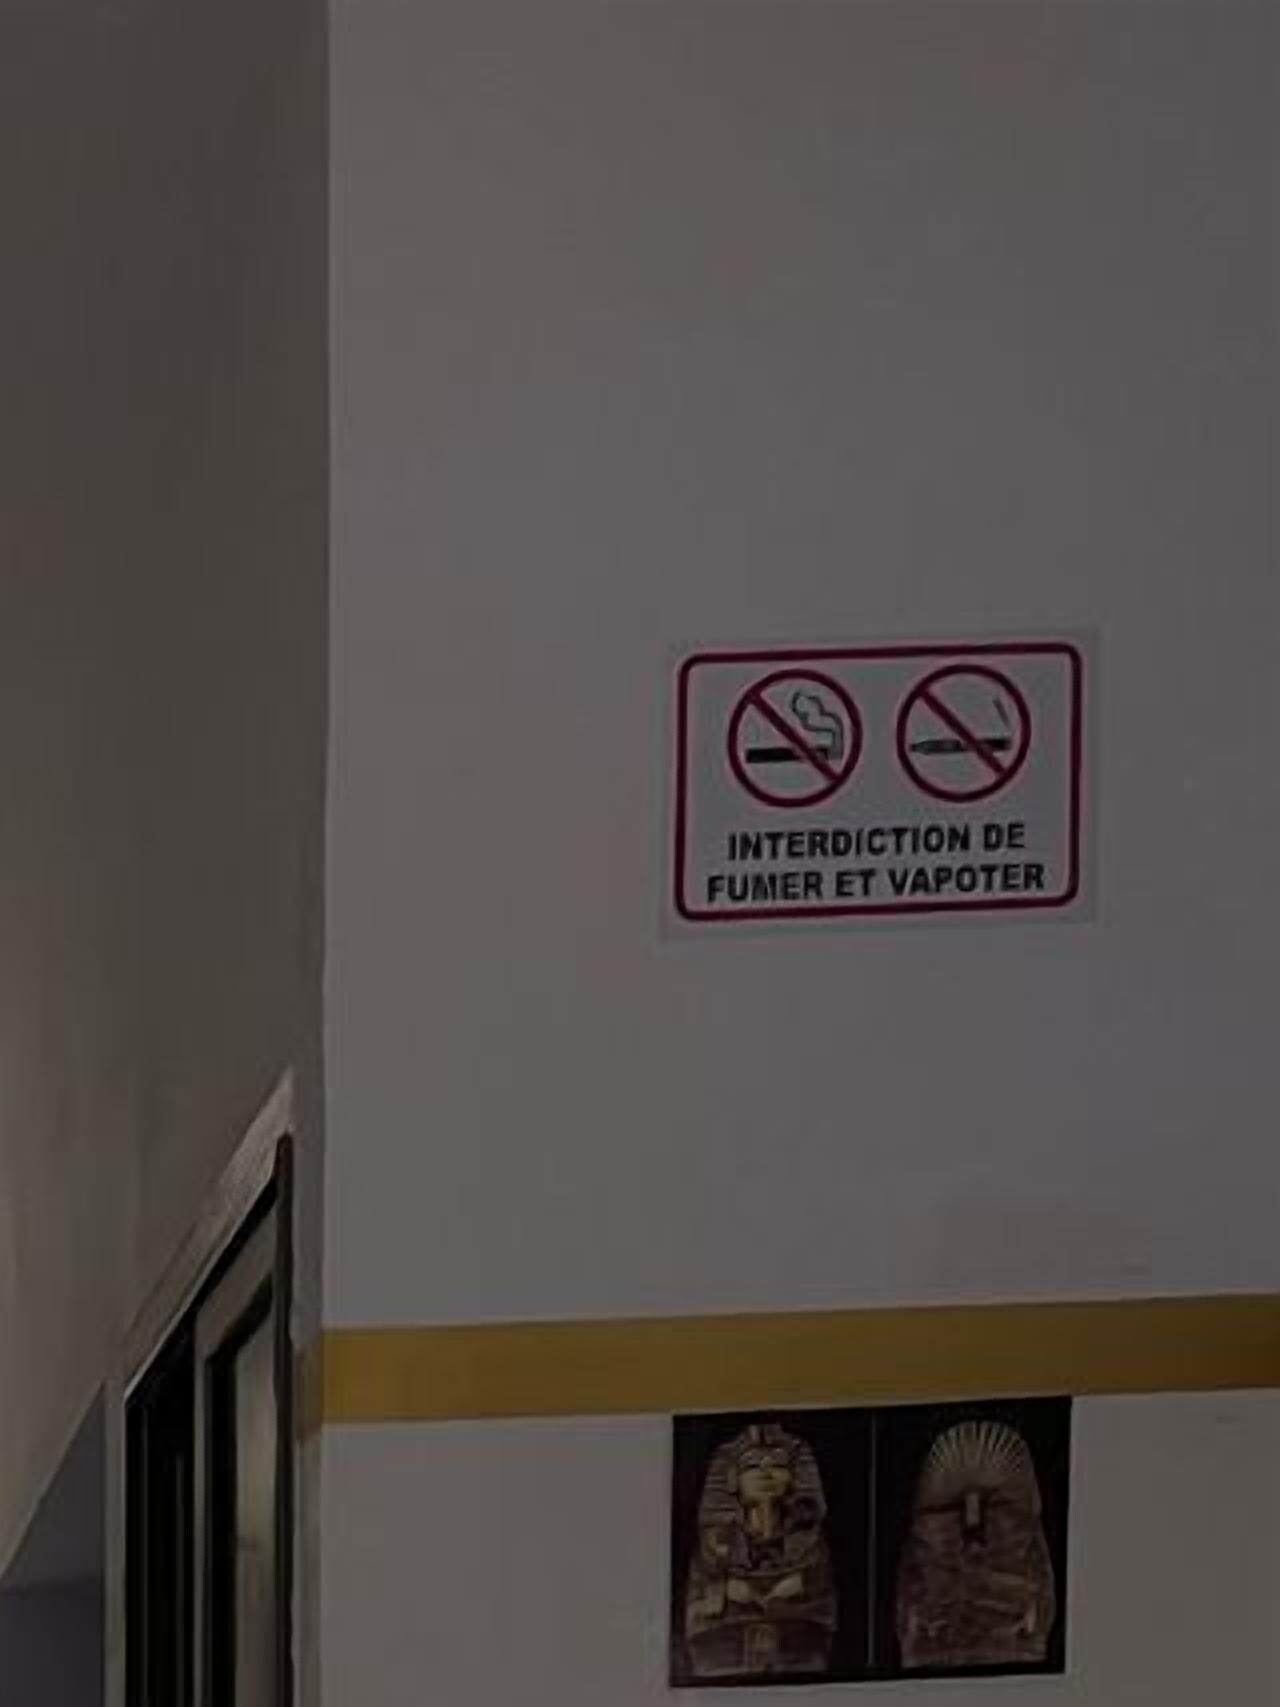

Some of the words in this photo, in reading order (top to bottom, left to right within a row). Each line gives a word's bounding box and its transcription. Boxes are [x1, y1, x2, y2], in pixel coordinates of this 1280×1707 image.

[727, 824, 971, 861] INTERDICTION
[982, 822, 1026, 851] DE
[707, 870, 823, 903] FUMER
[835, 868, 877, 897] ET
[888, 863, 1046, 896] VAPOTER
